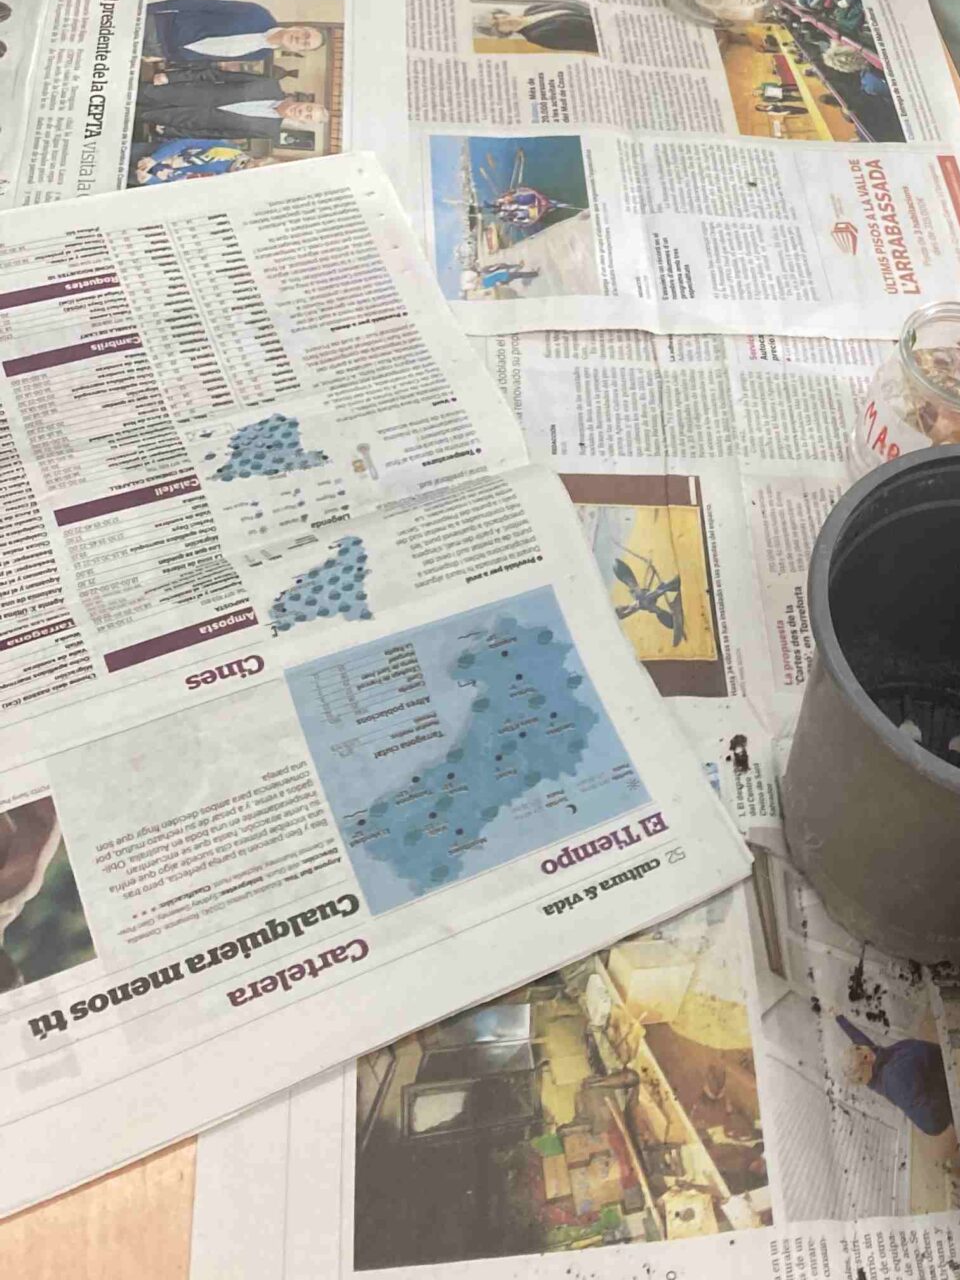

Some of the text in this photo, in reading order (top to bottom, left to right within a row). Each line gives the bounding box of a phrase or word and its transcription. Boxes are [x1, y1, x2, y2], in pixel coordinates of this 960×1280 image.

[95, 2, 115, 61] presidente
[92, 62, 110, 79] de
[90, 80, 108, 92] la
[84, 94, 106, 139] CEPTA
[79, 141, 97, 176] visita
[76, 179, 96, 191] la
[902, 185, 920, 229] habitacions
[848, 159, 898, 295] ÚLTIMS PISOS A LA VALL DE
[865, 159, 920, 294] L'ARRABASSADA
[65, 272, 118, 290] Roquetes
[90, 333, 141, 351] Cambrils
[768, 337, 780, 361] precio
[496, 348, 508, 385] doblado
[511, 356, 522, 410] renovado su
[154, 476, 200, 496] Calafell
[184, 535, 219, 548] Migración
[158, 553, 184, 565] quedan
[503, 556, 536, 571] Previsió
[711, 541, 720, 568] paredes
[465, 573, 483, 584] avui
[214, 597, 250, 612] AMPOSTA
[716, 588, 726, 621] instalado
[196, 611, 254, 634] Amposta
[794, 586, 811, 649] en Torreforta
[4, 622, 74, 645] Tarragona
[776, 620, 793, 686] La propuesta
[785, 604, 805, 685] 'Cartes des de la
[185, 655, 264, 690] Cines
[729, 675, 737, 696] Hasta
[231, 790, 252, 803] para
[160, 810, 199, 829] deciden
[115, 833, 134, 845] que
[136, 824, 160, 838] fingir
[146, 827, 184, 845] rechazo
[184, 829, 209, 843] boda
[95, 840, 115, 852] son
[541, 812, 668, 874] El Tiempo
[95, 851, 112, 864] por
[102, 859, 126, 873] Obli-
[126, 851, 179, 875] encuentran
[180, 849, 214, 866] sucede
[138, 870, 157, 882] que
[158, 862, 178, 875] algo
[142, 877, 165, 893] pero
[542, 846, 687, 916] 52 cultura & vida
[122, 887, 141, 899] tras
[186, 894, 359, 973] Cualquiera
[227, 939, 368, 1006] Cartelera
[70, 963, 184, 1020] menos
[28, 1010, 68, 1039] tú
[769, 1239, 778, 1255] un
